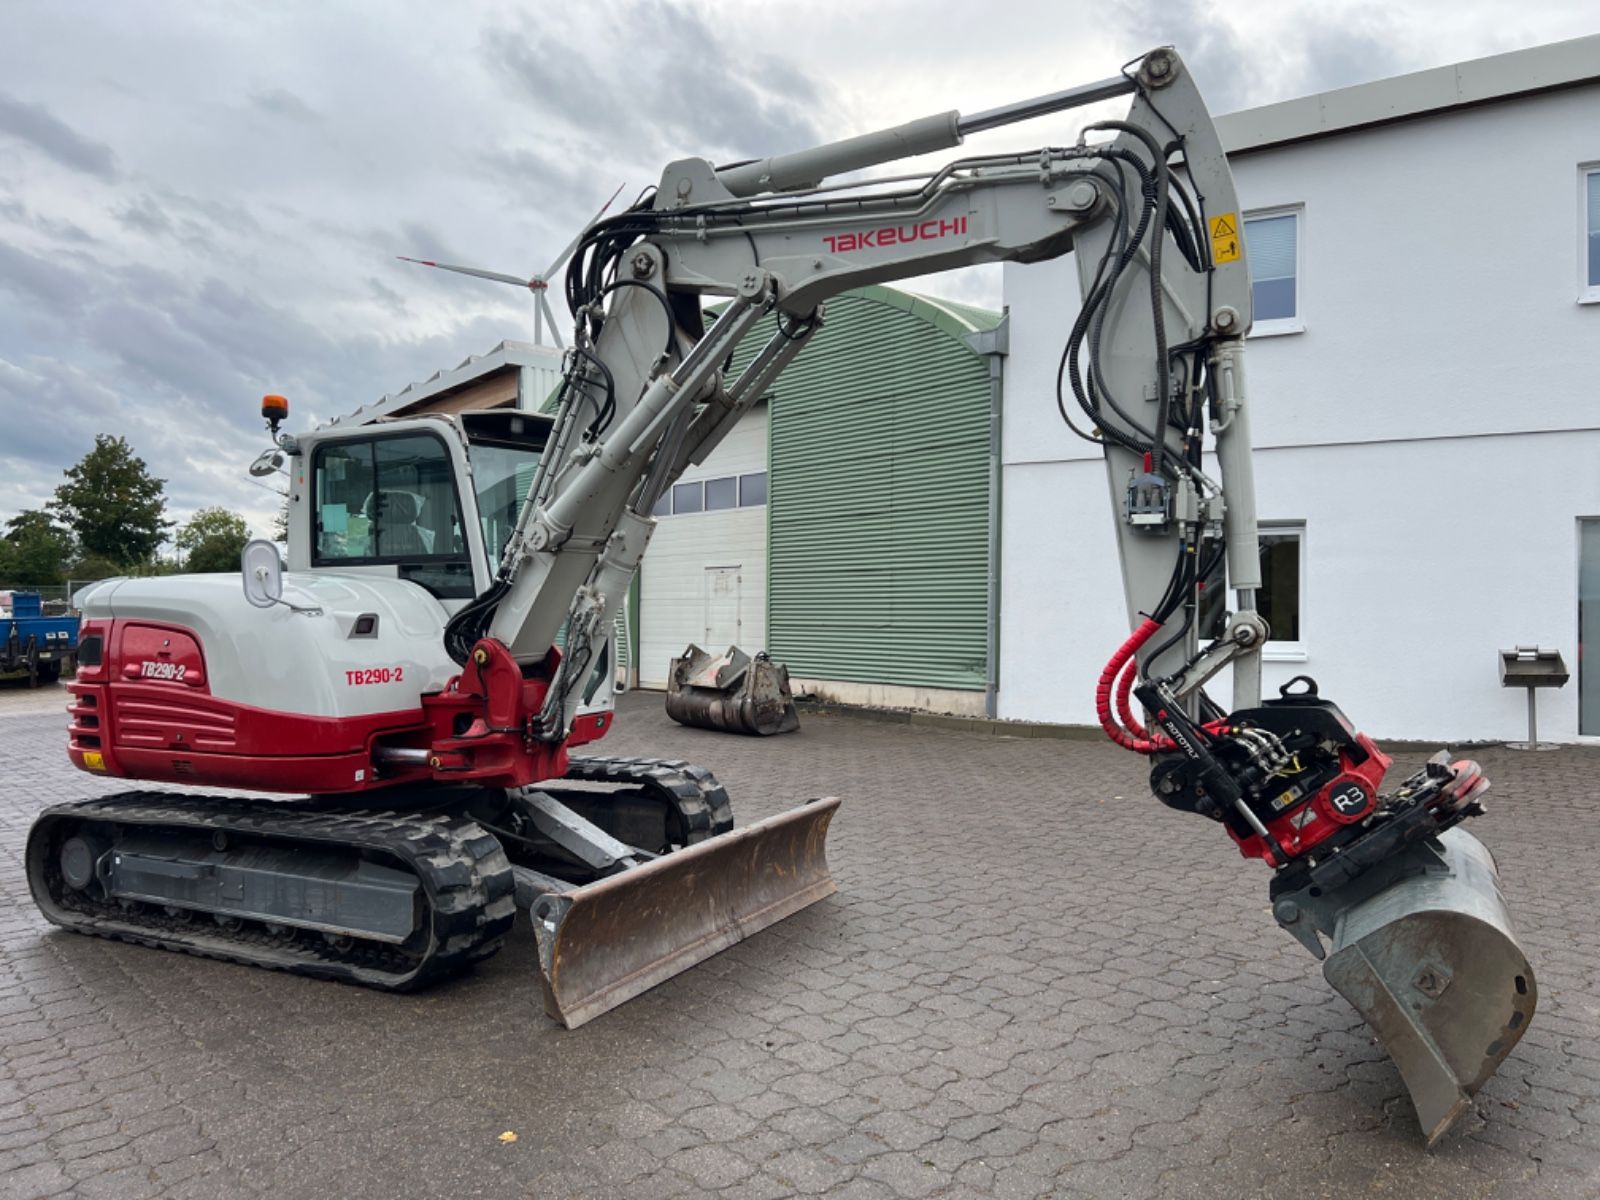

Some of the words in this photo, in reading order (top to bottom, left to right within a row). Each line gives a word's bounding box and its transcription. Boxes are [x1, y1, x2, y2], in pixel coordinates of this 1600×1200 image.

[141, 661, 186, 680] TB290-2
[345, 667, 403, 686] TB290-2
[1334, 787, 1364, 812] R3
